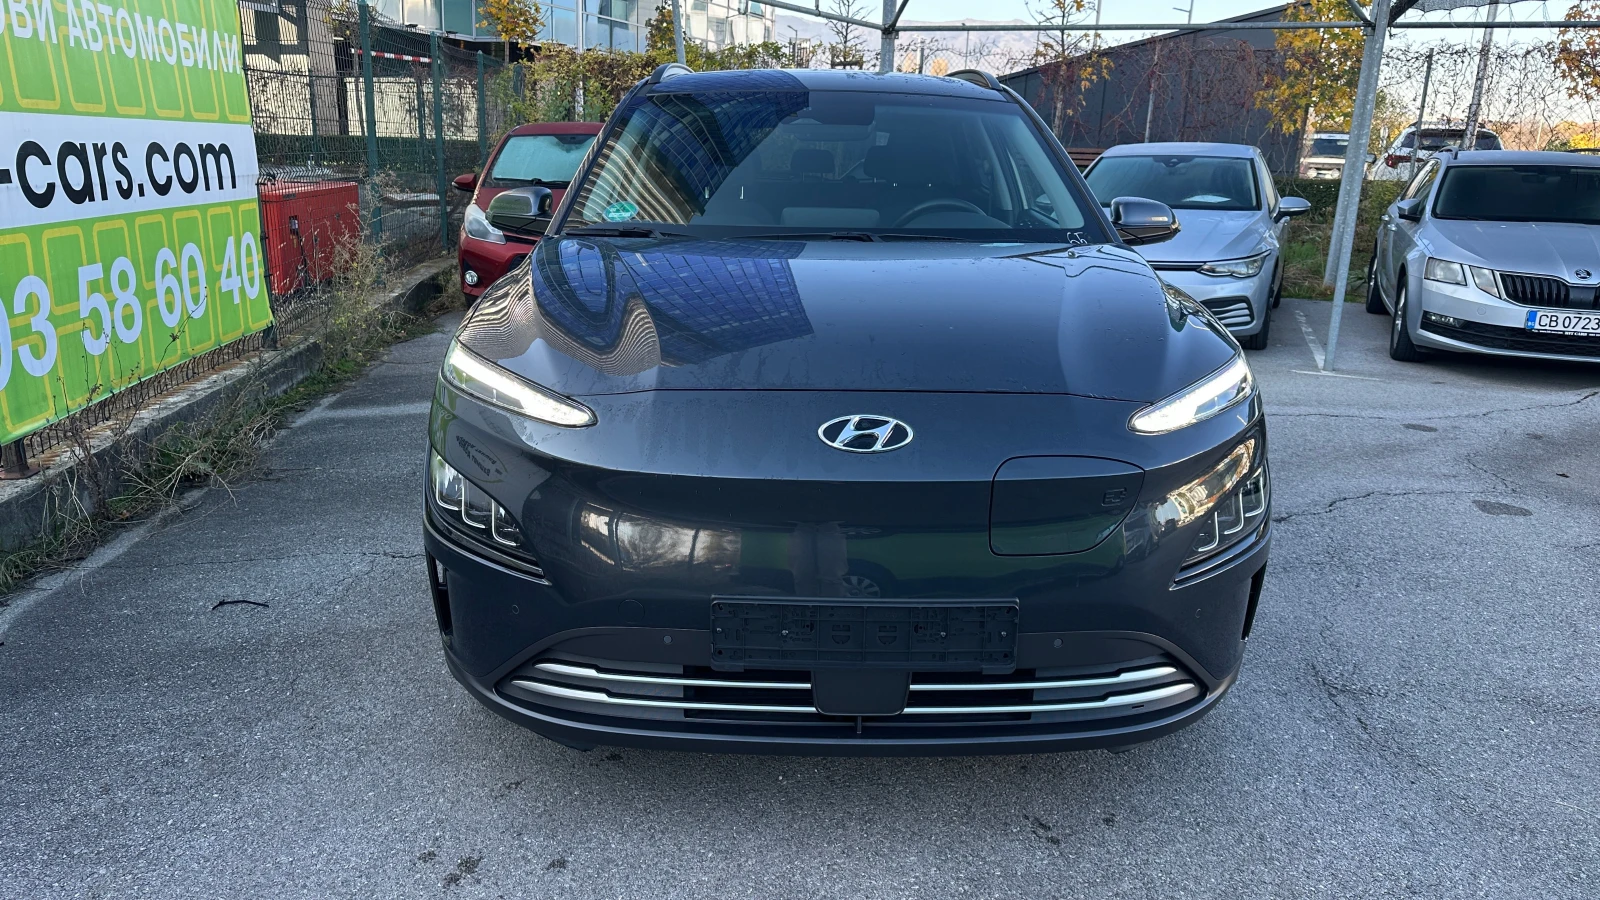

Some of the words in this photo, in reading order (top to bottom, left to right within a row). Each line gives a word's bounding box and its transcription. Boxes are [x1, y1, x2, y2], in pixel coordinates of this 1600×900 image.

[0, 0, 58, 44] ВИ
[66, 0, 241, 75] АВТОМОБИЛИ
[0, 275, 58, 392] 3
[78, 256, 143, 356] 58
[155, 242, 207, 328] 60
[221, 231, 260, 305] 40
[1538, 314, 1559, 328] CB
[1562, 316, 1600, 331] 0723
